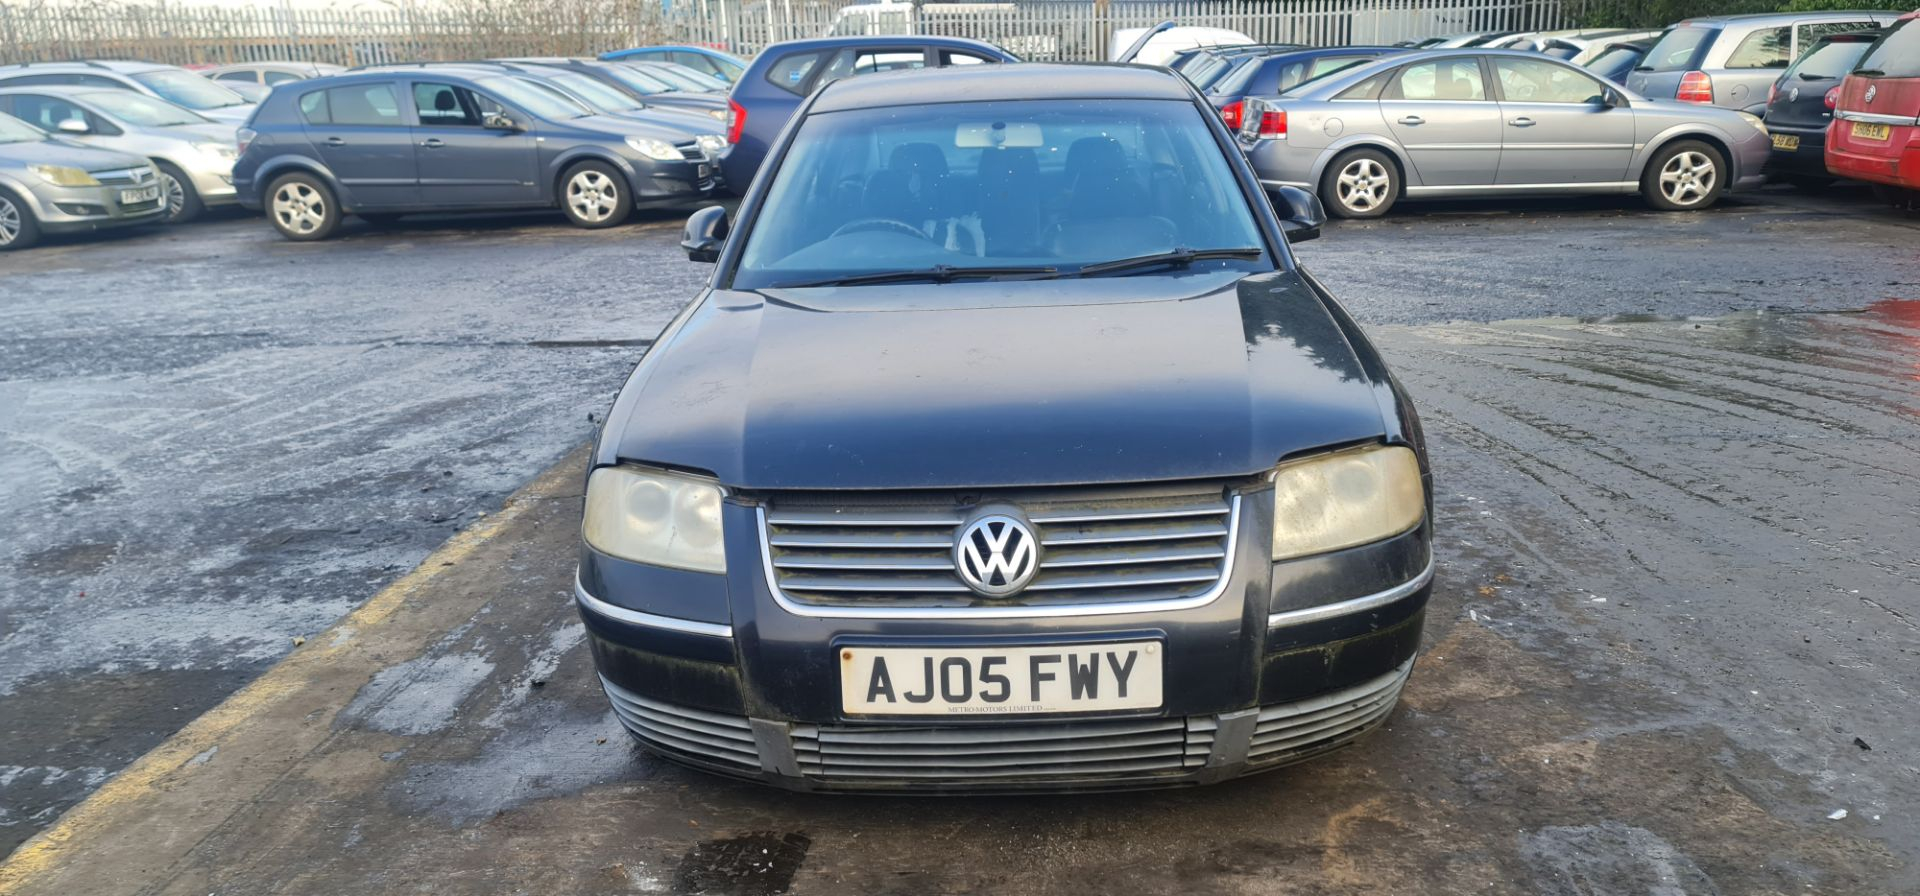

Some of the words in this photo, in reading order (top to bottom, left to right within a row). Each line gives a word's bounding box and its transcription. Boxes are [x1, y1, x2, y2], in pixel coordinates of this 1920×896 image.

[866, 656, 1011, 703] AJ05
[1029, 650, 1138, 702] FWY
[1009, 705, 1043, 713] LIMITED
